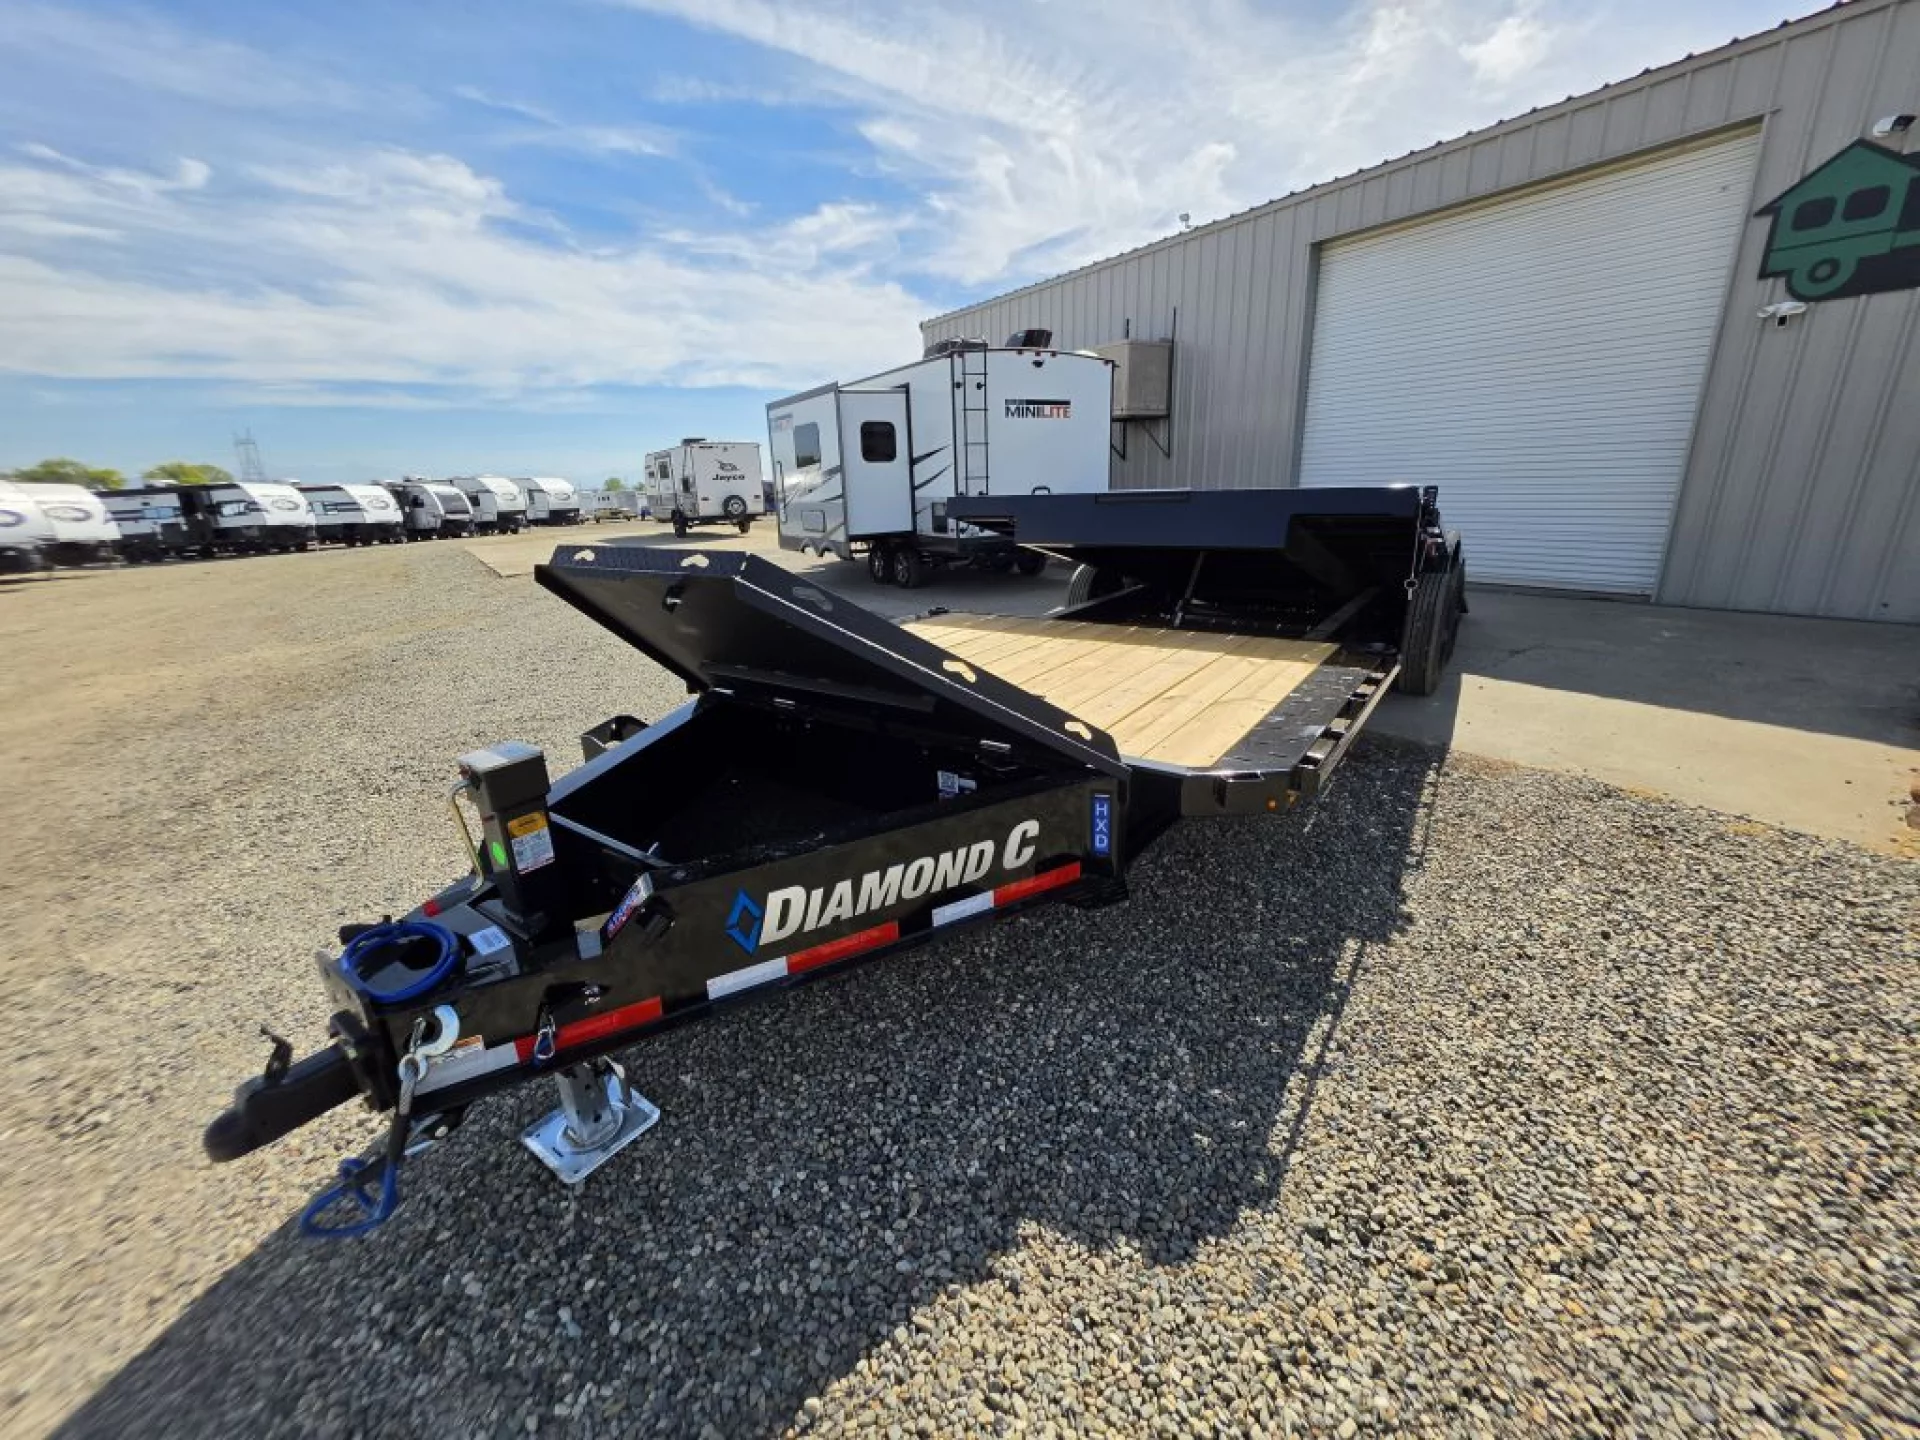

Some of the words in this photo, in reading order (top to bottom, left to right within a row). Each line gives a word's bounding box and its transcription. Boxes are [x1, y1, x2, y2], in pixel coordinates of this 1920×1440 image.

[712, 473, 745, 482] Jayco
[1095, 802, 1109, 848] HXD
[759, 840, 995, 946] DIAMOND
[1003, 819, 1040, 870] C
